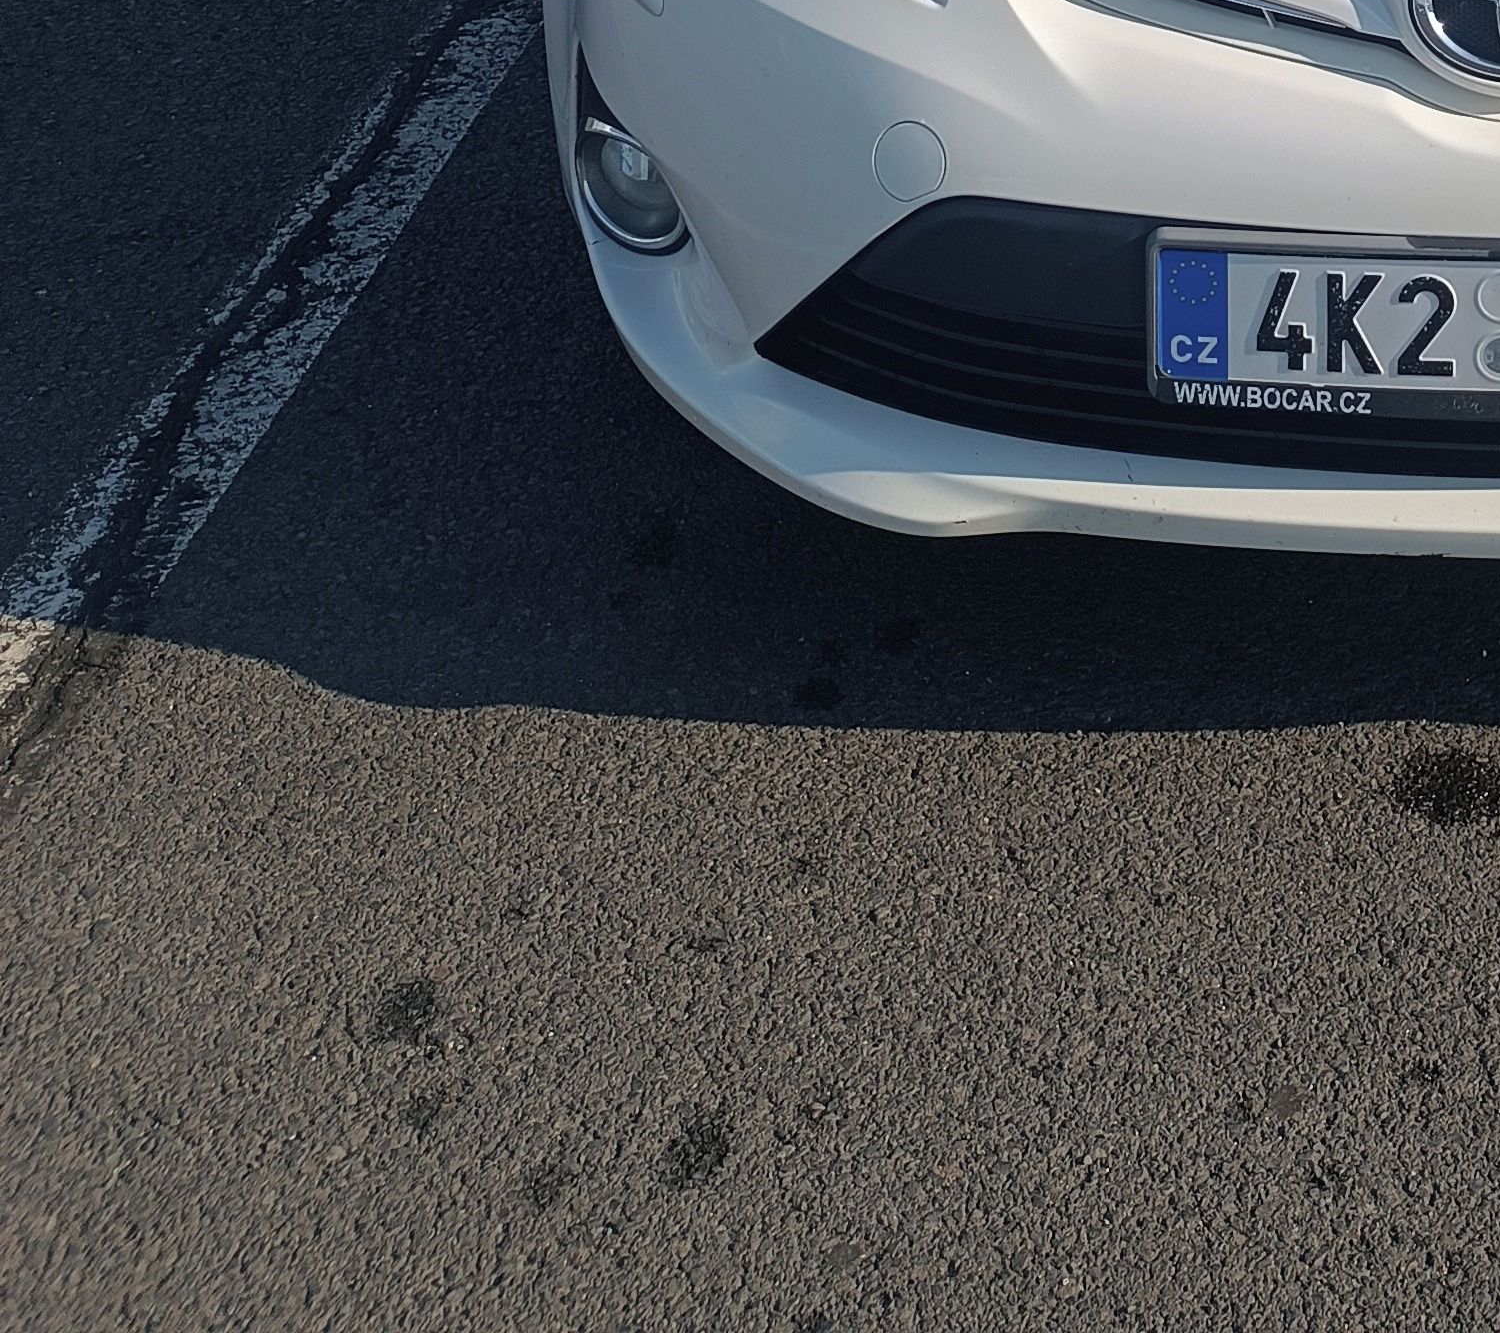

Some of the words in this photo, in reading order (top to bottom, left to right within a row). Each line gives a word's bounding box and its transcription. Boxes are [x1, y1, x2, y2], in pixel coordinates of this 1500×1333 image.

[1256, 269, 1457, 378] 4K2
[1169, 335, 1219, 364] CZ
[1173, 382, 1371, 414] WWW.BOCAR.CZ
